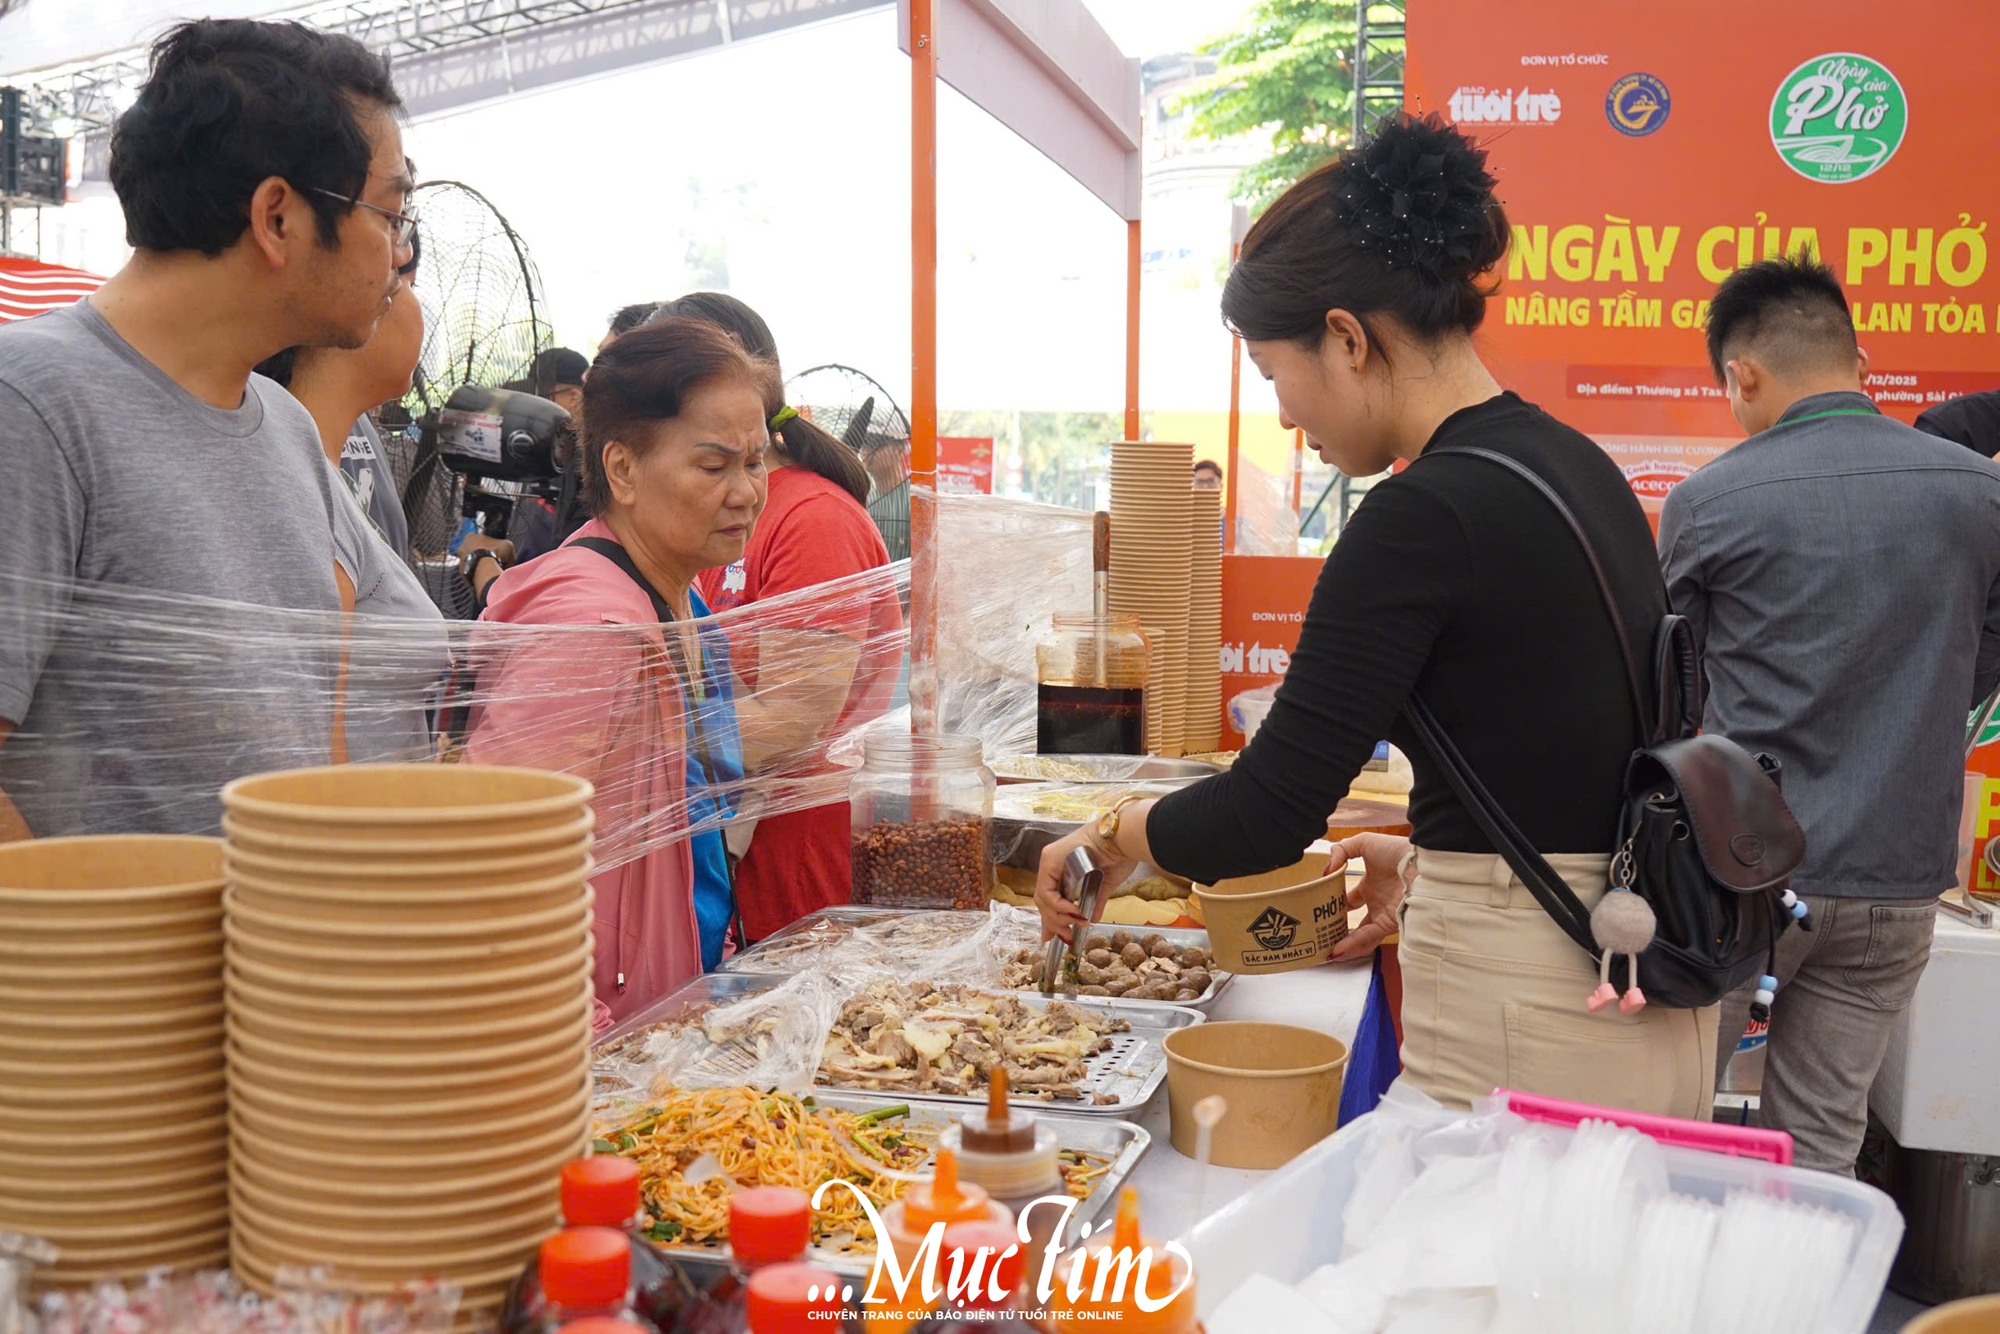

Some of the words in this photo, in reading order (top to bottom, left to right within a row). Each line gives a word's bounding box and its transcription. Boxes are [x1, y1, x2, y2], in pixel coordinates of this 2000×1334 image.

[1521, 55, 1546, 66] ĐƠN
[1548, 56, 1559, 67] VỊ
[1560, 53, 1575, 65] TỔ
[1577, 54, 1608, 65] CHỨC
[1818, 58, 1871, 84] Ngày
[1864, 78, 1890, 92] của
[1784, 75, 1891, 135] Phở
[1508, 213, 1681, 282] NGÀY
[1846, 213, 1987, 287] PHỞ
[1506, 291, 1590, 327] NÂNG
[1599, 289, 1662, 327] TẦM
[1852, 303, 1913, 333] LAN
[1922, 296, 1986, 333] TỎA
[1864, 373, 1918, 386] /12/2025
[1576, 383, 1597, 396] Địa
[1636, 385, 1681, 398] Thương
[1684, 385, 1699, 397] xá
[1701, 387, 1722, 397] Tax
[1875, 390, 1924, 404] phường
[1926, 391, 1946, 402] Sài
[1252, 612, 1276, 621] ĐƠN
[1277, 613, 1288, 624] VỊ
[1246, 640, 1291, 675] trẻ
[1313, 895, 1337, 923] PHỞ
[1263, 954, 1281, 962] NAM
